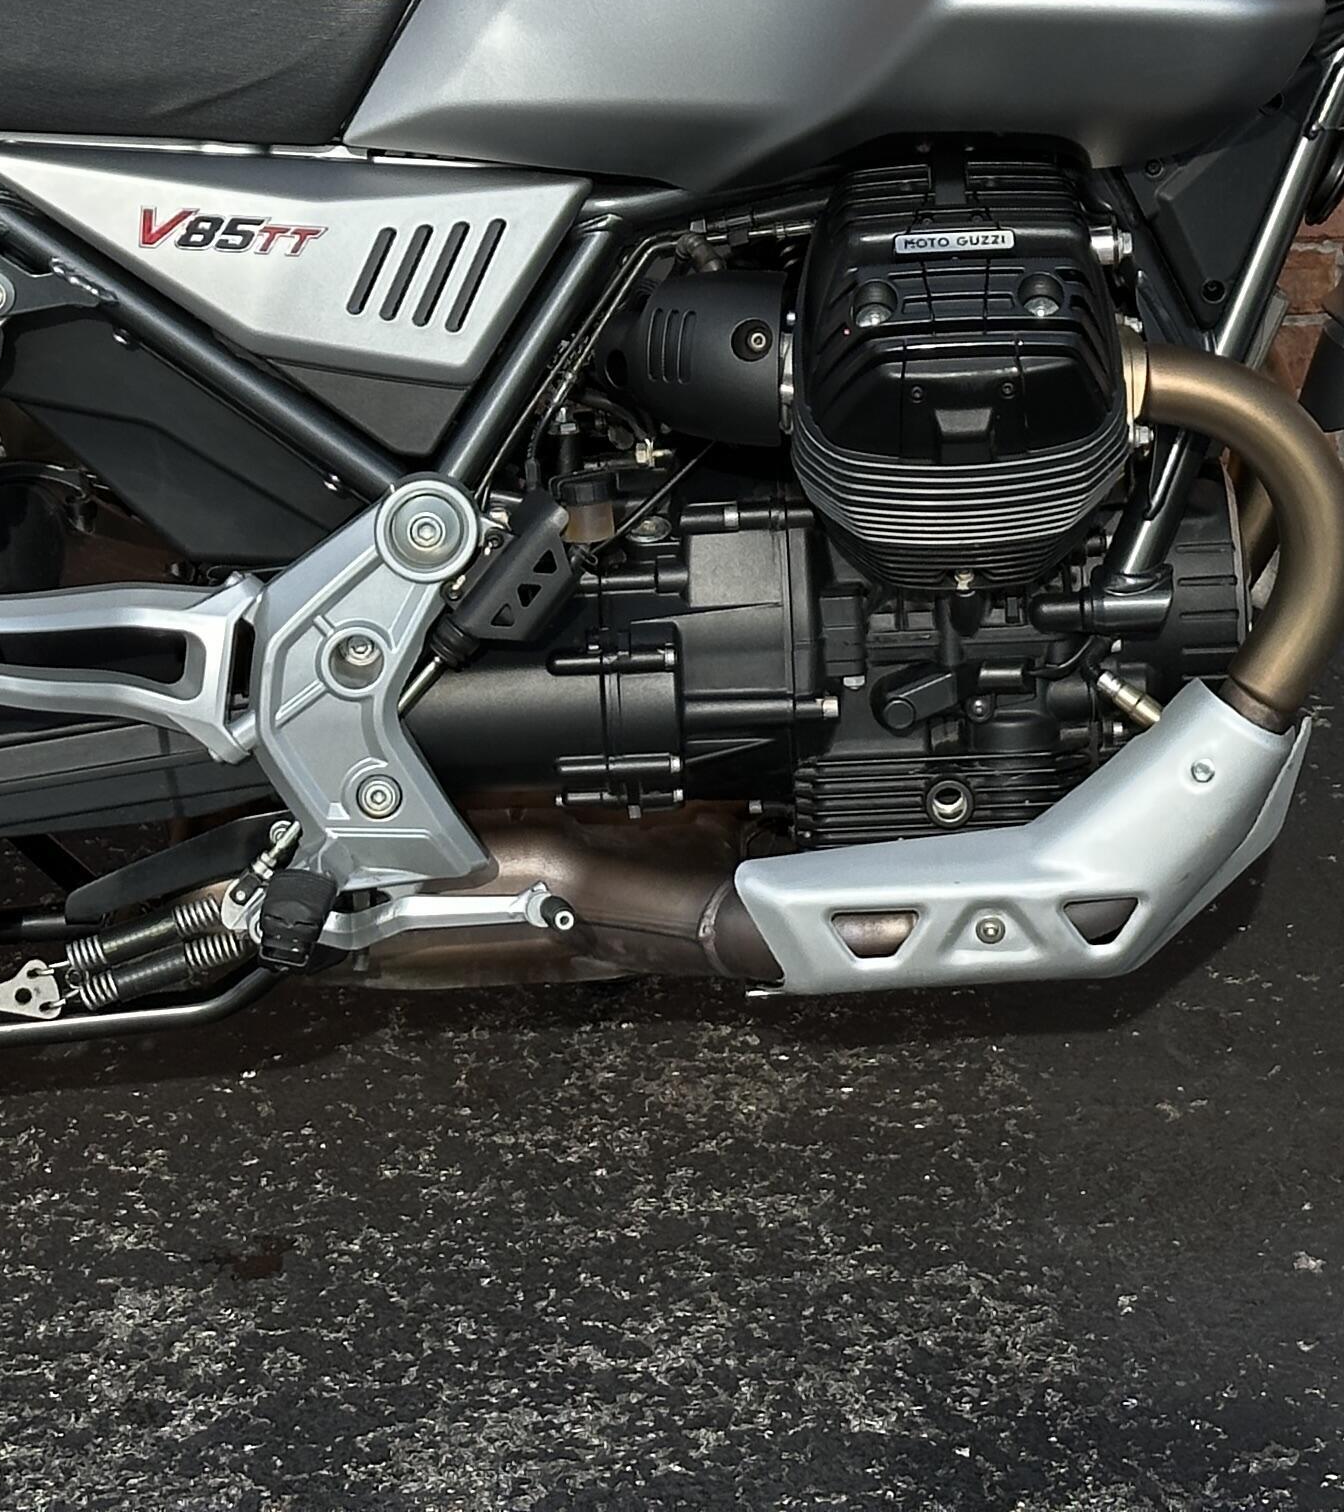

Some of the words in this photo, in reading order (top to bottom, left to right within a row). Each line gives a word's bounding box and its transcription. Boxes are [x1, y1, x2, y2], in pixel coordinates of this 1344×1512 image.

[138, 205, 329, 257] V85TT
[903, 237, 950, 250] MOTO
[955, 234, 1006, 247] GUZZI
